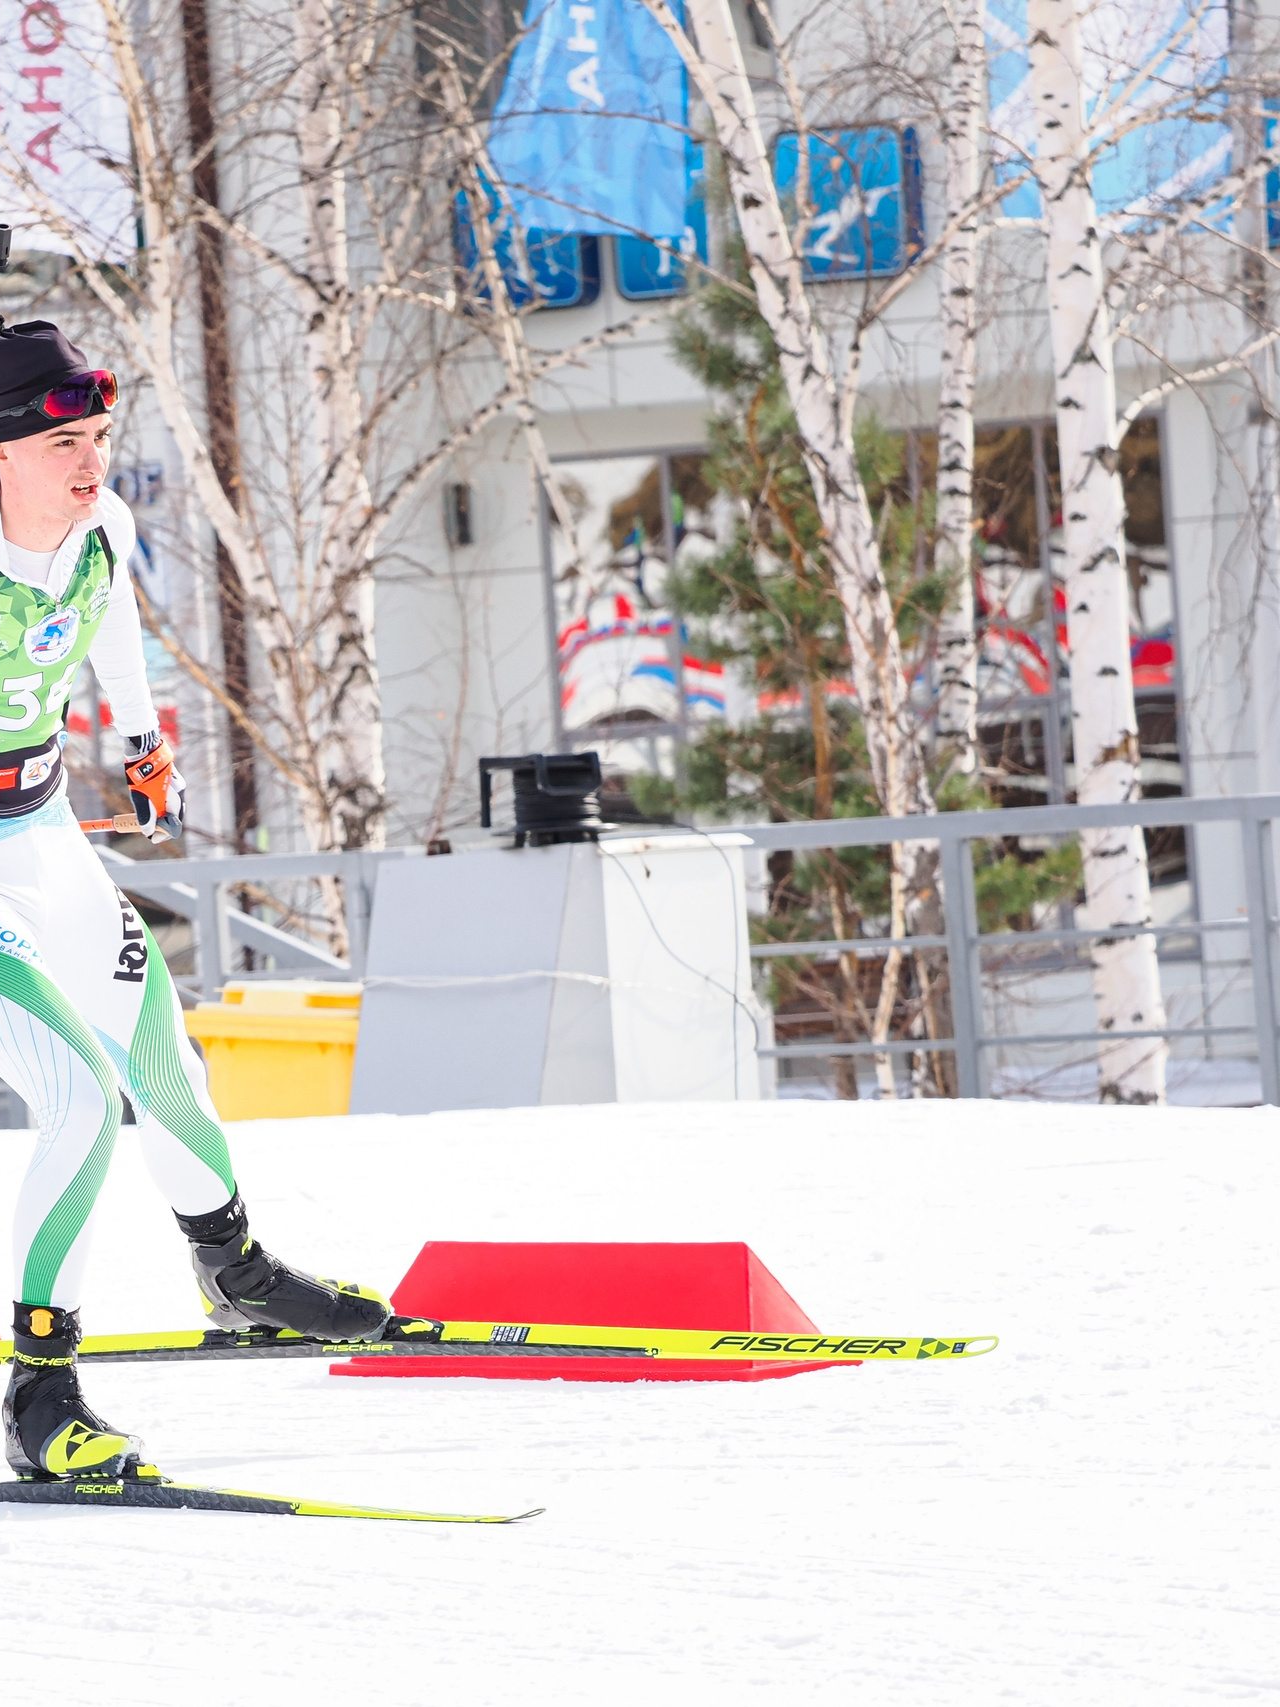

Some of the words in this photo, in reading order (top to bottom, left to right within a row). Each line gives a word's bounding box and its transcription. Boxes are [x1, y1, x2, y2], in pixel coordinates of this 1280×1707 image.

[322, 1344, 394, 1353] FISCHER
[709, 1335, 907, 1356] FISCHER
[14, 1350, 74, 1366] FISCHER
[75, 1484, 124, 1494] FISCHER
